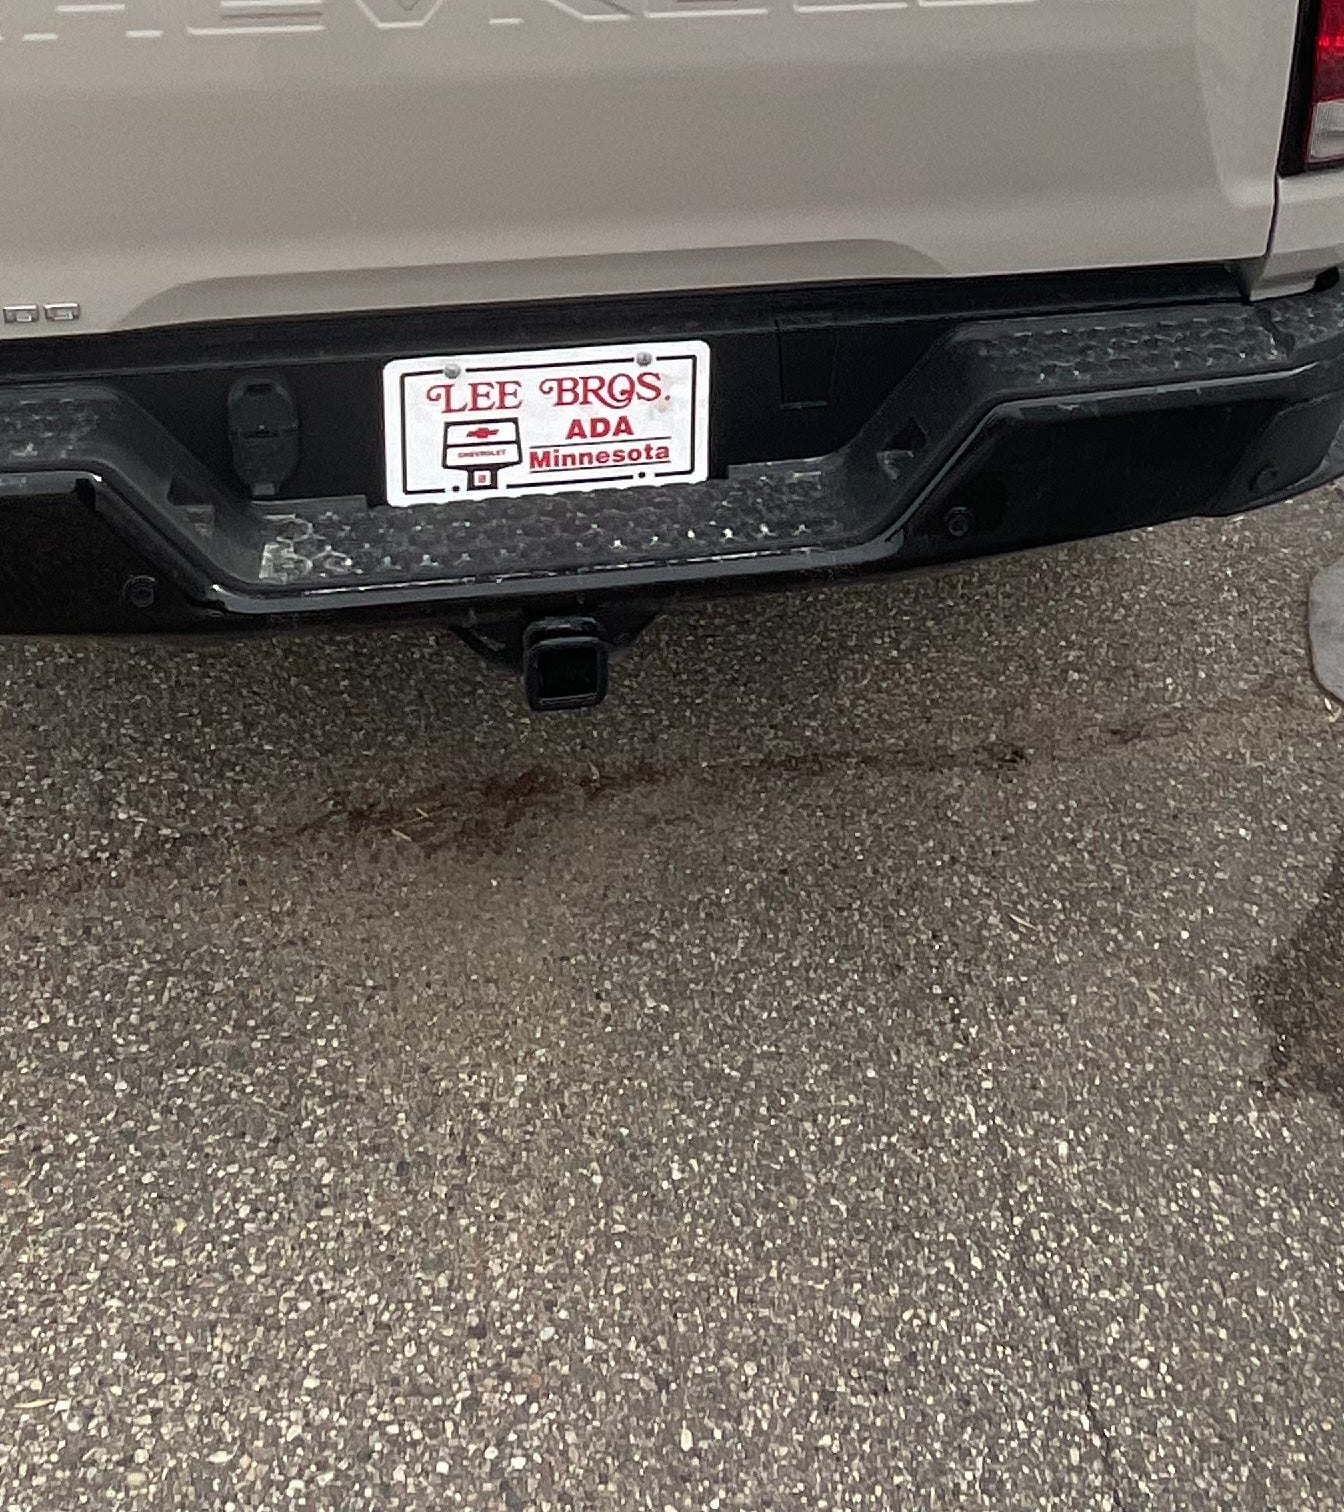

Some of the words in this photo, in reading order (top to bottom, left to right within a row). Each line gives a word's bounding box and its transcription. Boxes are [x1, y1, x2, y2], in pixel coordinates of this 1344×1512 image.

[426, 380, 523, 414] LEE
[539, 372, 672, 410] BROS.
[565, 415, 635, 441] ADA
[528, 442, 671, 470] Minnesota
